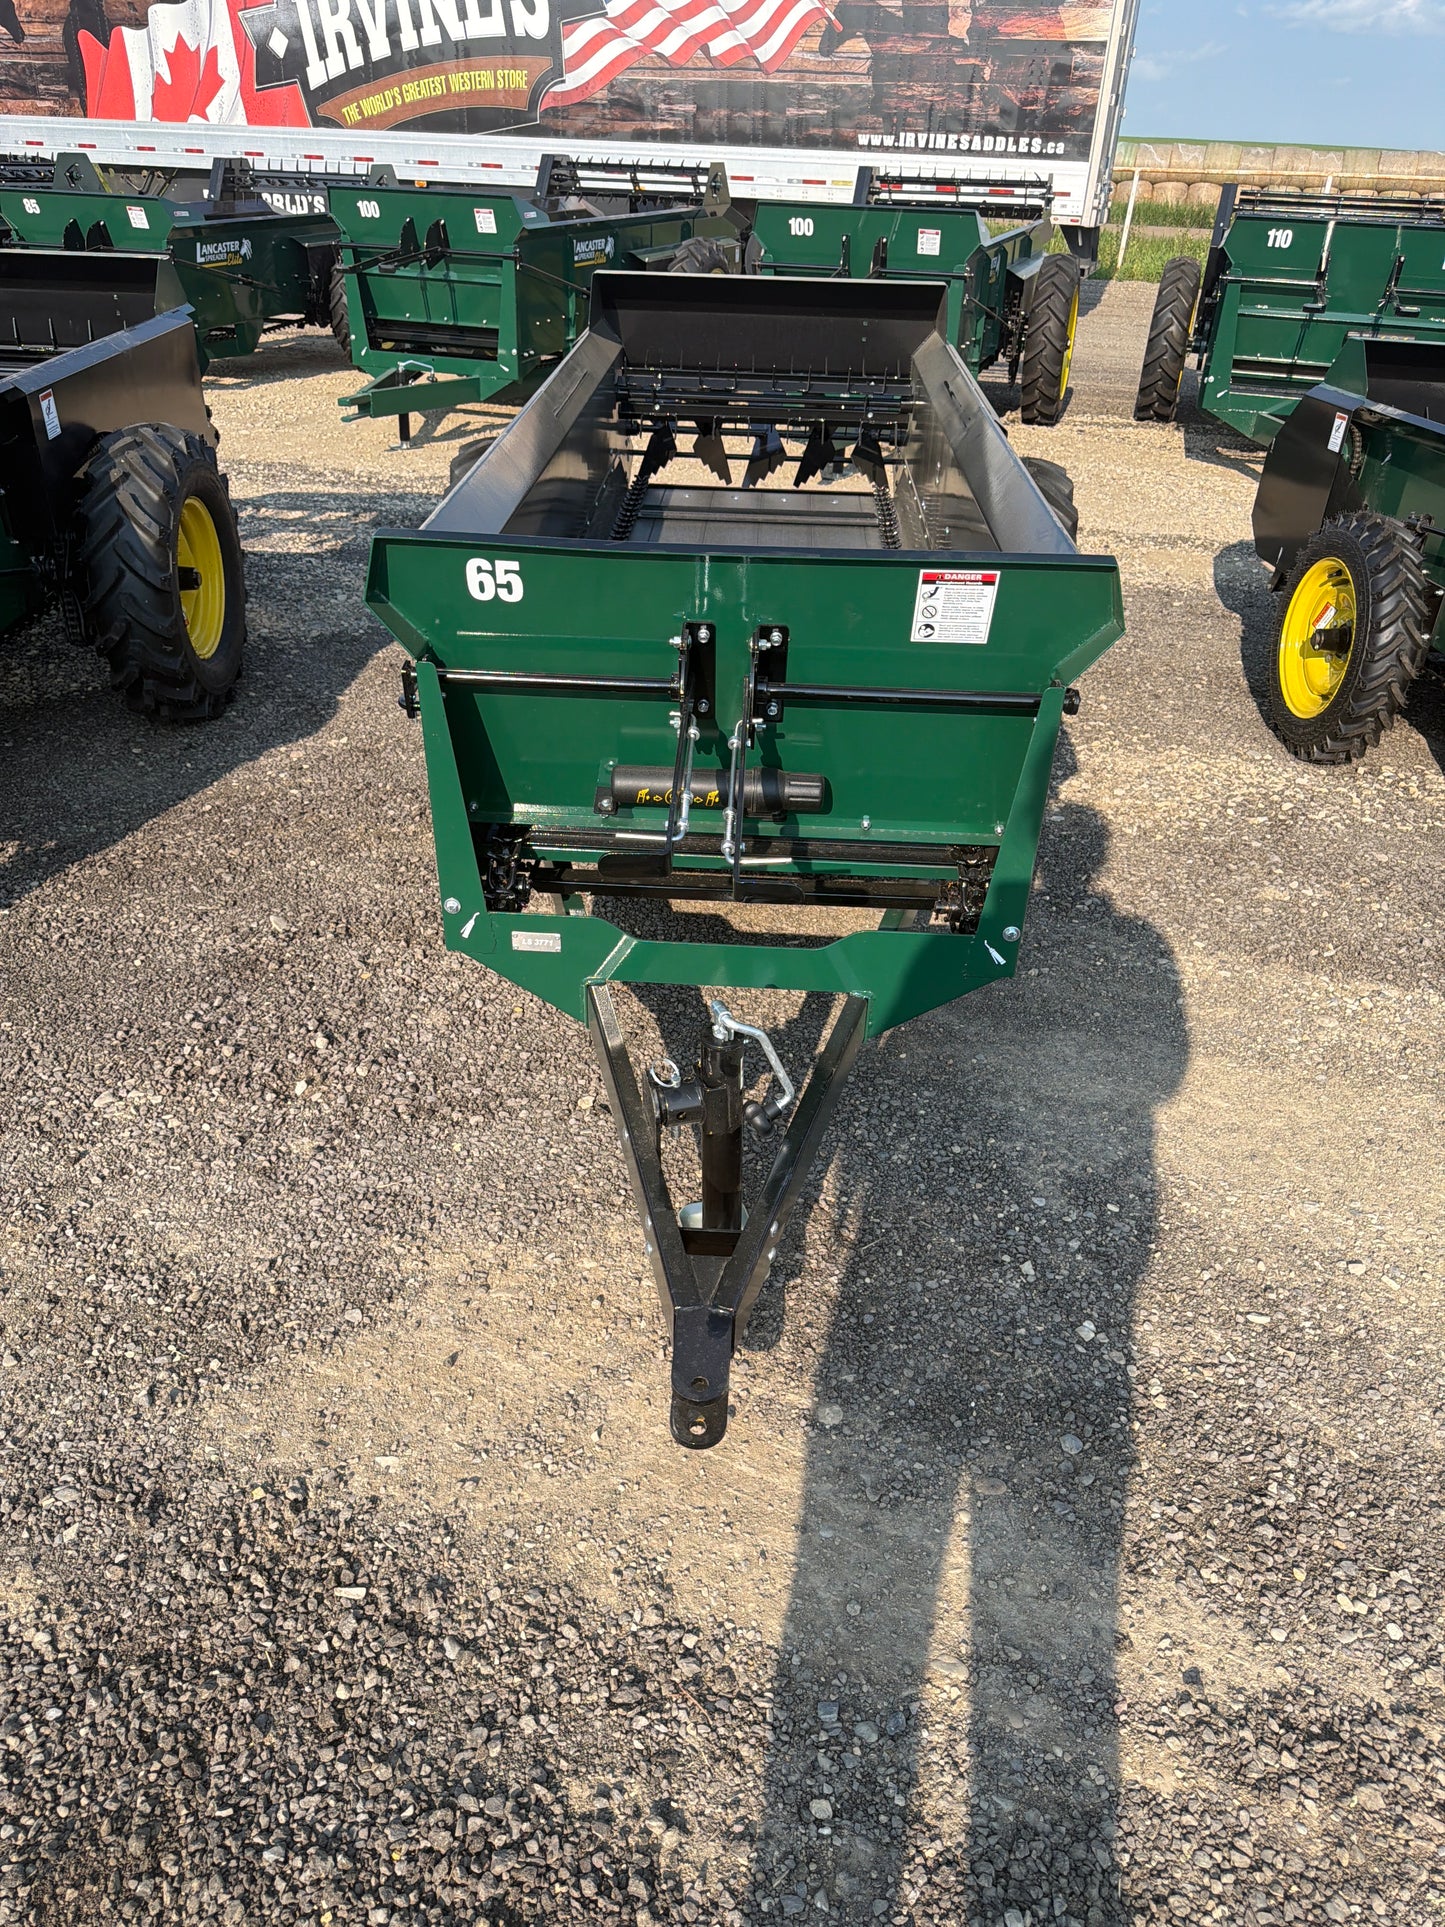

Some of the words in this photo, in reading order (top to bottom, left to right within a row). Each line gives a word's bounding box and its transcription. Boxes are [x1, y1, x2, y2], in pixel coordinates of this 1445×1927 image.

[342, 101, 362, 126] THE
[359, 86, 402, 117] WORLD'S
[401, 75, 448, 103] GREATEST
[448, 70, 495, 93] WESTERN
[496, 69, 528, 89] STORE
[857, 132, 1066, 155] www.IRVINESADDLES.ca
[22, 198, 41, 214] 85
[356, 200, 381, 218] 100
[788, 217, 814, 237] 100
[573, 238, 606, 261] LANCASTER
[1267, 228, 1293, 249] 110
[196, 240, 240, 263] LANCASTER
[465, 557, 524, 603] 65
[944, 573, 983, 581] DANGER
